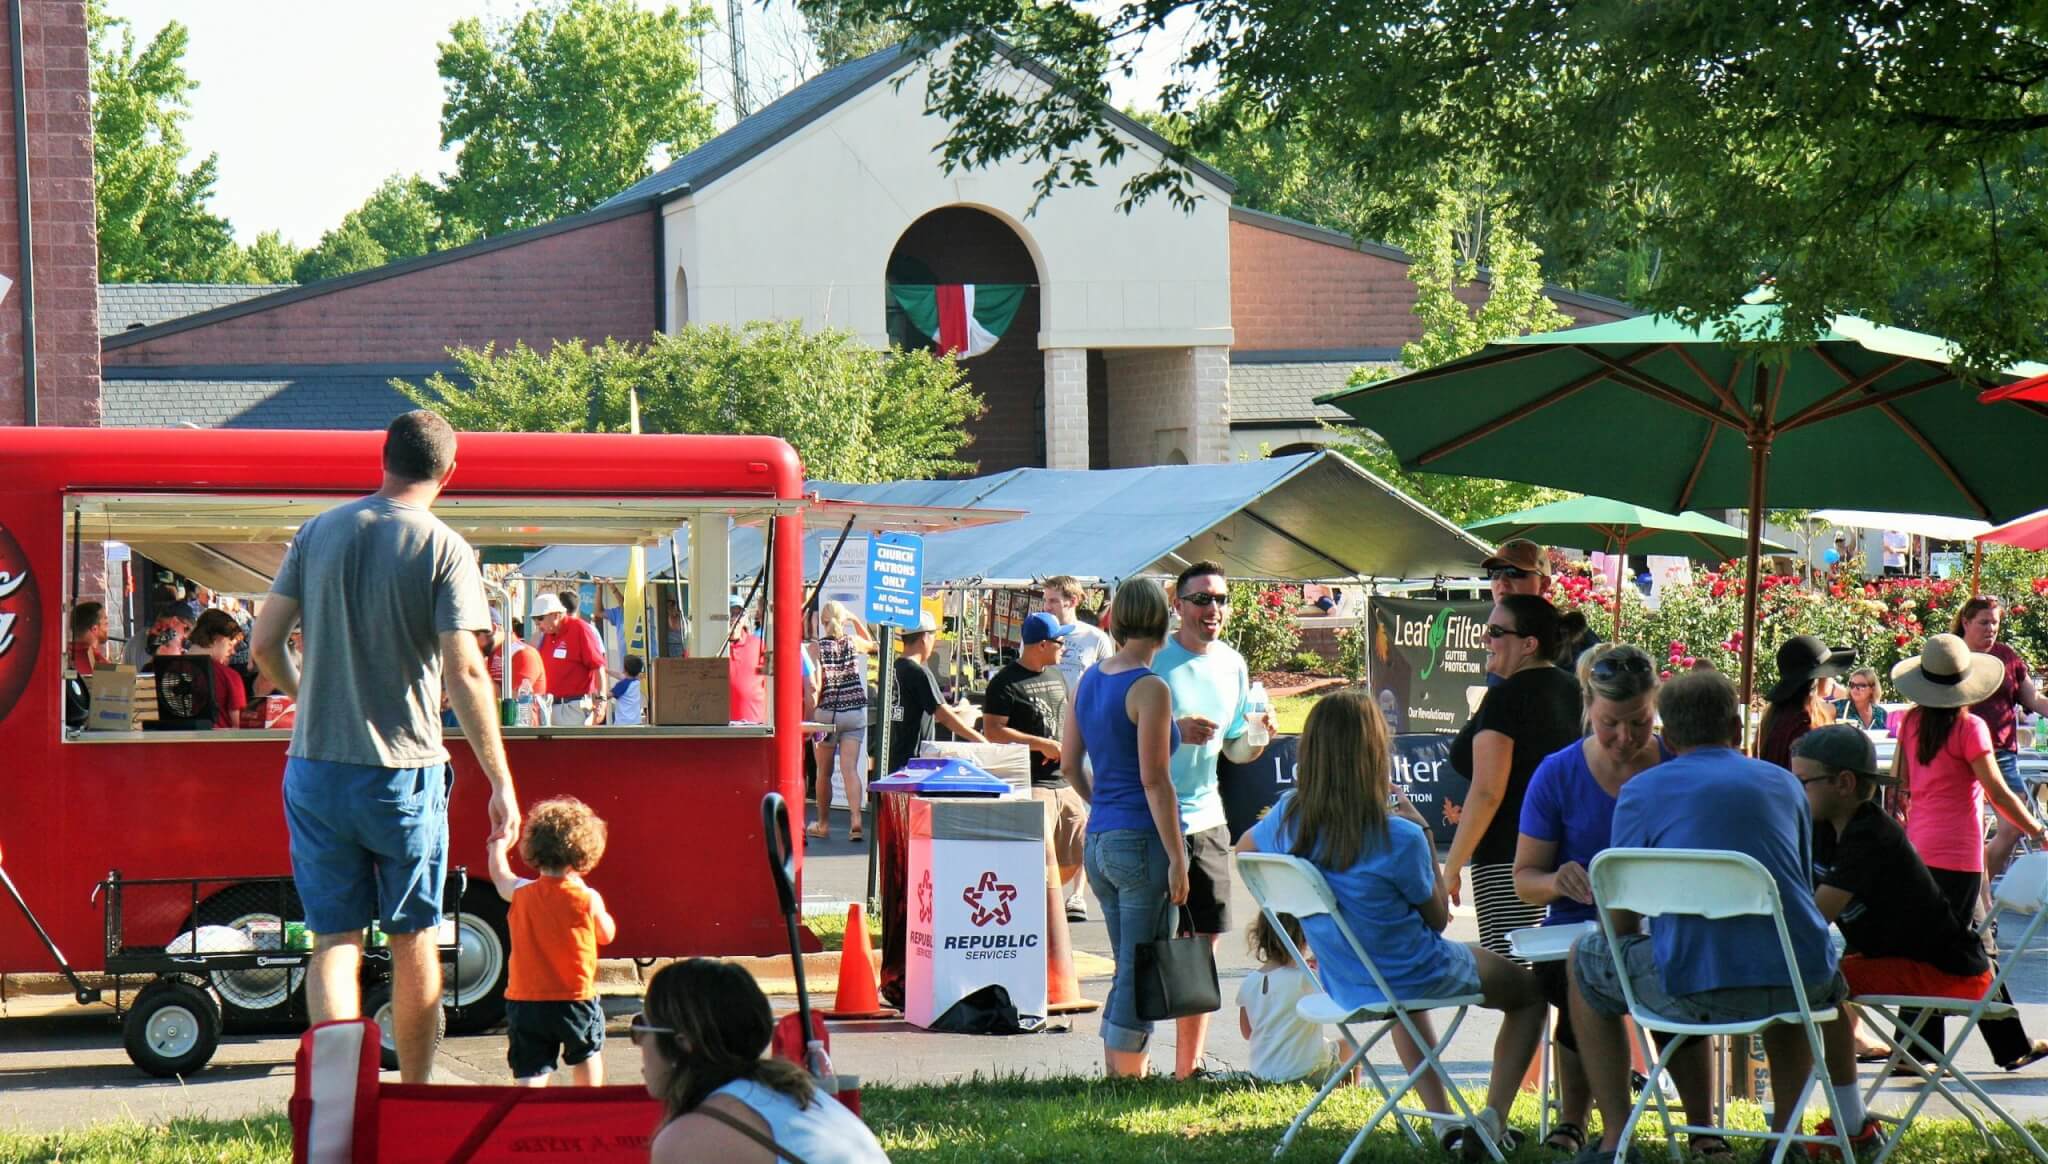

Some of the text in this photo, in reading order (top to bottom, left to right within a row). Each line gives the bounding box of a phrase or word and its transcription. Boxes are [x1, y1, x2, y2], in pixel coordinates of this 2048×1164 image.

[878, 547, 914, 562] CHURCH
[874, 560, 915, 576] PATRONS
[882, 575, 906, 588] ONLY
[879, 593, 909, 605] All Others
[873, 602, 914, 616] Will Be Towed
[1394, 614, 1433, 647] Leaf
[1445, 651, 1467, 661] GUTTER
[1445, 662, 1480, 673] PROTECTION
[1408, 706, 1455, 724] Our Revolutionary
[944, 934, 1038, 949] REPUBLIC
[965, 950, 1017, 960] SERVICES
